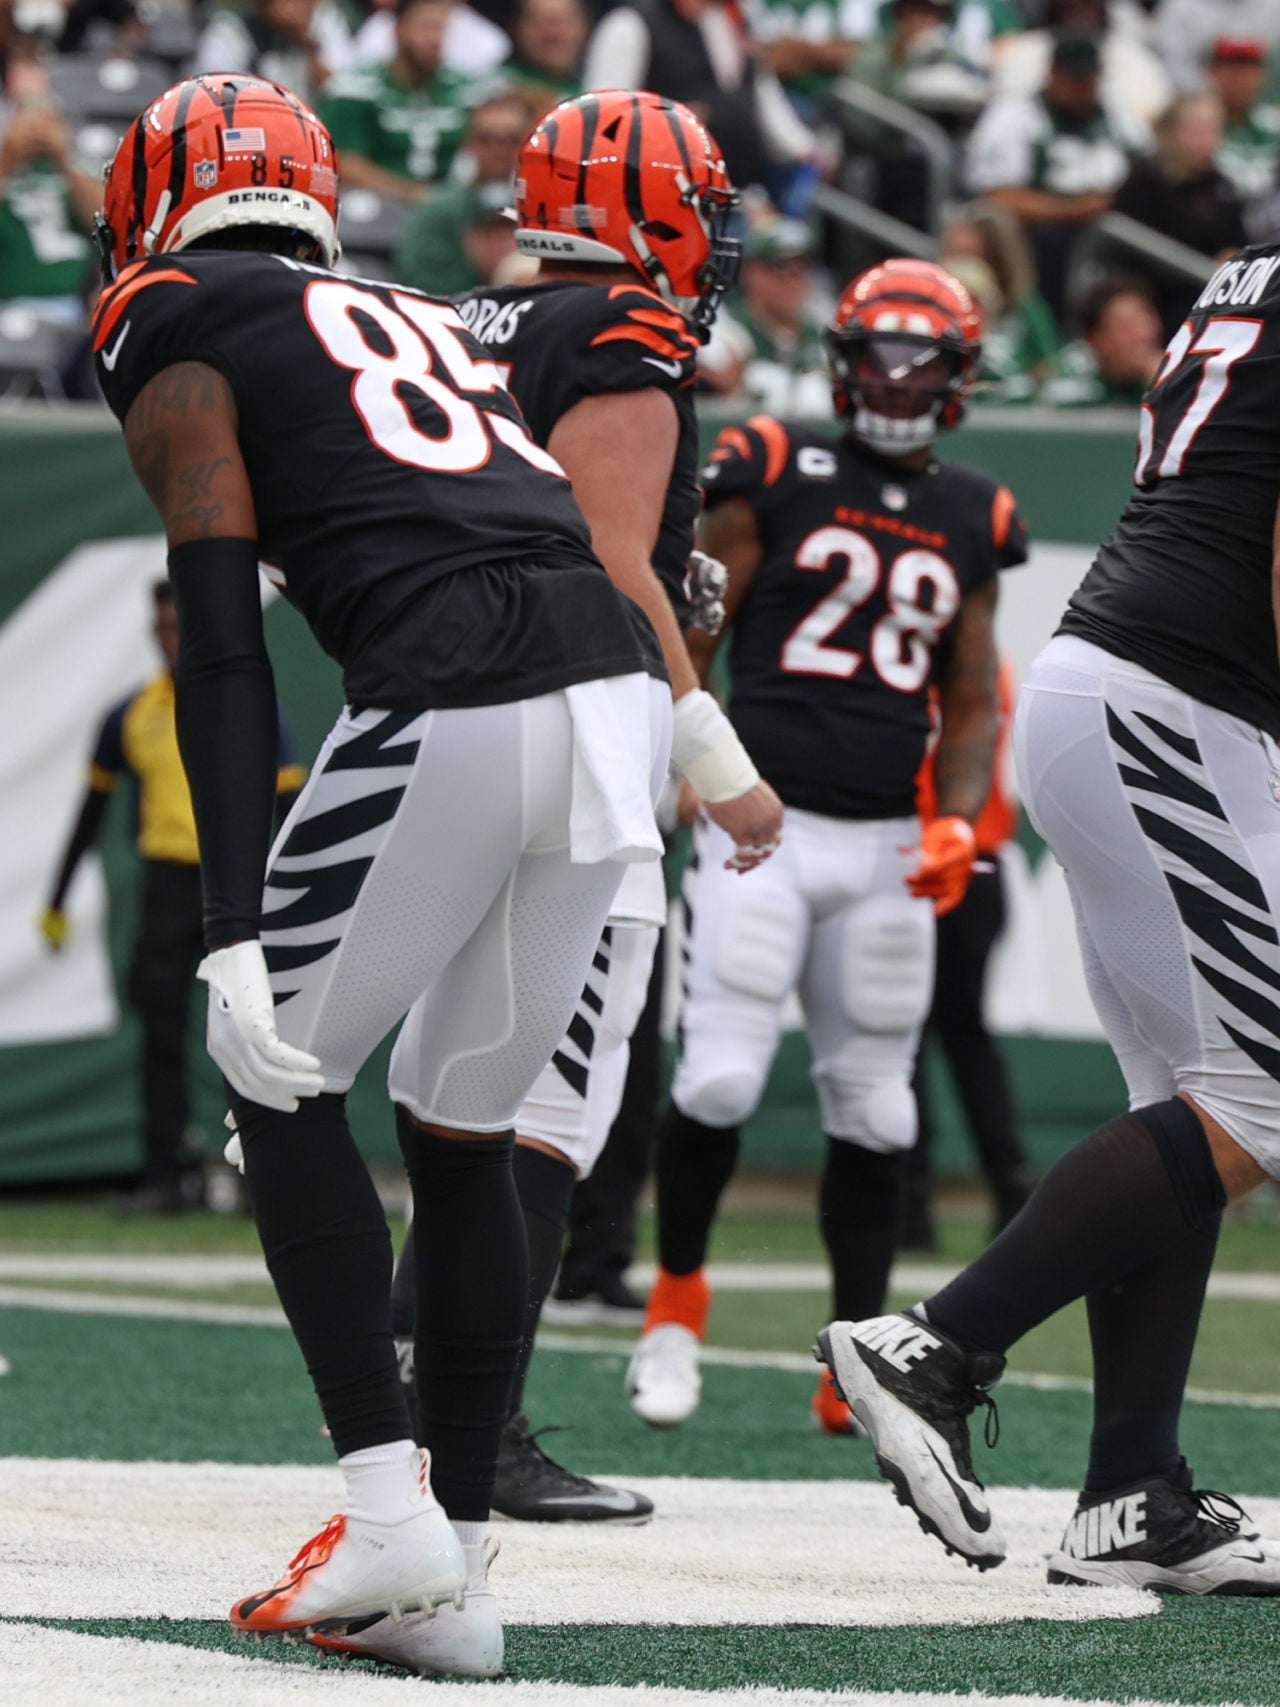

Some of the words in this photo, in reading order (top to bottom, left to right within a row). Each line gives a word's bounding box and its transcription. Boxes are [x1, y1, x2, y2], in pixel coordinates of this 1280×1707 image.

[228, 191, 310, 210] BENGAS
[250, 153, 294, 188] 85
[303, 280, 568, 473] 85
[779, 523, 960, 694] 28
[850, 1315, 944, 1374] NIKE
[1061, 1491, 1148, 1560] NIKE
